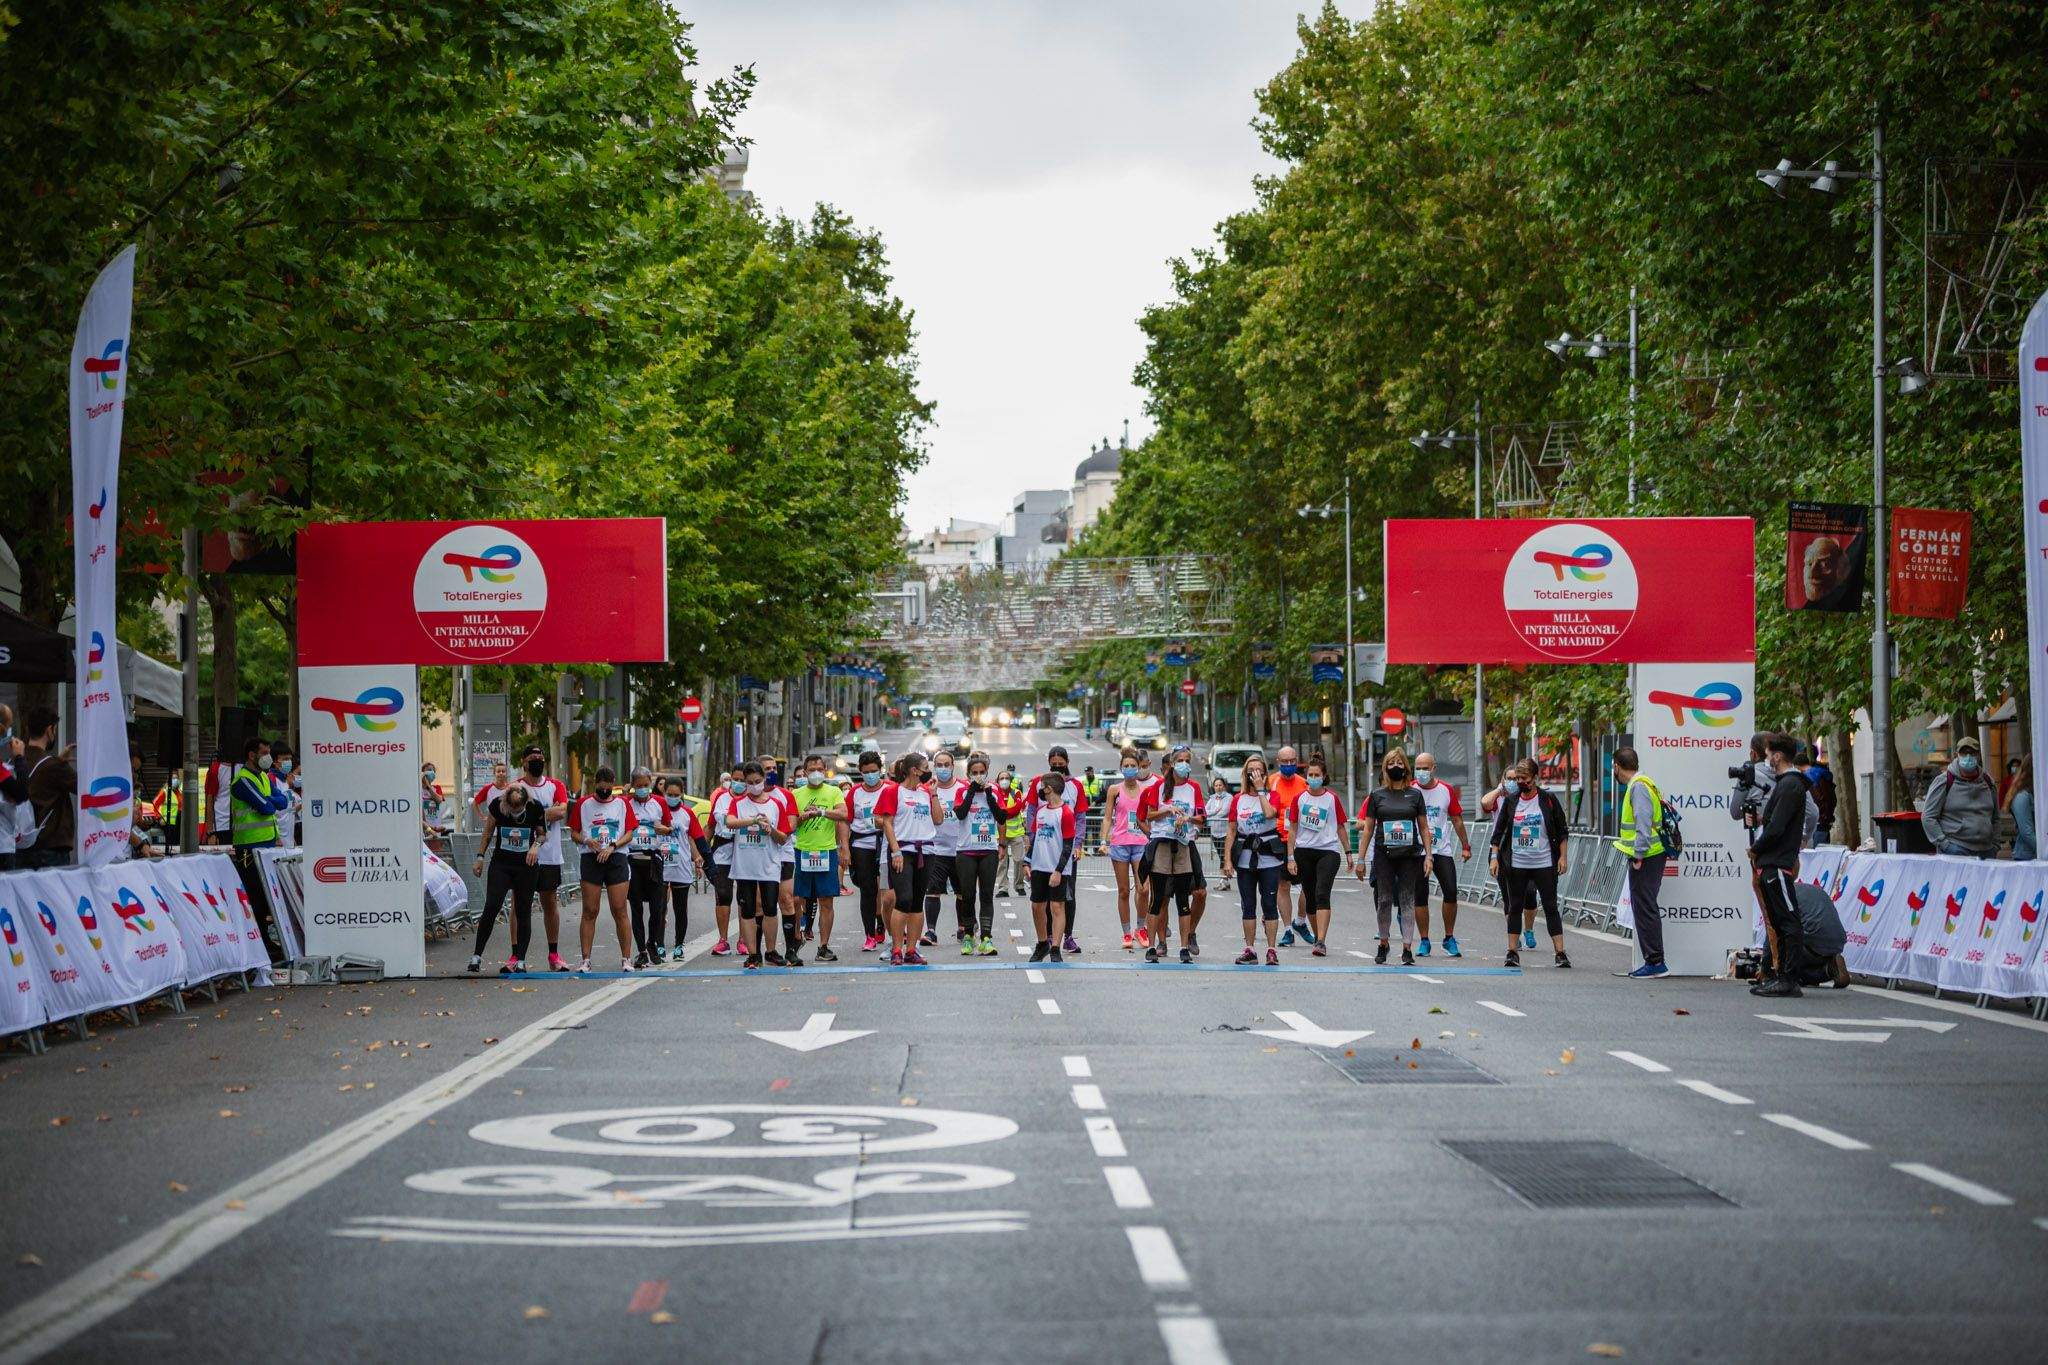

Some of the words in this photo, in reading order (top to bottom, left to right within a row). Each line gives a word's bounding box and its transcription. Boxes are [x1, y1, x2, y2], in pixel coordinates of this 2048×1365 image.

[1900, 528, 1961, 542] FERNÁN
[1899, 540, 1961, 556] GÓMEZ
[1911, 556, 1948, 565] CENTRO
[1905, 564, 1953, 573] CULTURAL
[1898, 571, 1910, 579] DE
[1931, 574, 1959, 582] VILLA
[443, 590, 522, 602] TotalEnergies
[1533, 589, 1613, 602] TotalEnergies
[463, 614, 500, 624] MILLA
[1553, 613, 1590, 623] MILLA
[449, 638, 465, 648] DE
[467, 637, 515, 648] MADRID
[1539, 637, 1555, 647] DE
[1558, 636, 1604, 647] MADRID
[312, 741, 406, 755] TotalEnergies
[1648, 736, 1743, 751] TotalEnergies
[335, 799, 411, 815] MADRID
[1671, 795, 1730, 809] MADRI
[977, 834, 992, 843] 1105
[352, 856, 401, 867] MILLA
[1685, 851, 1734, 862] MILLA
[351, 870, 409, 882] URBANA
[1683, 865, 1742, 877] URBANA
